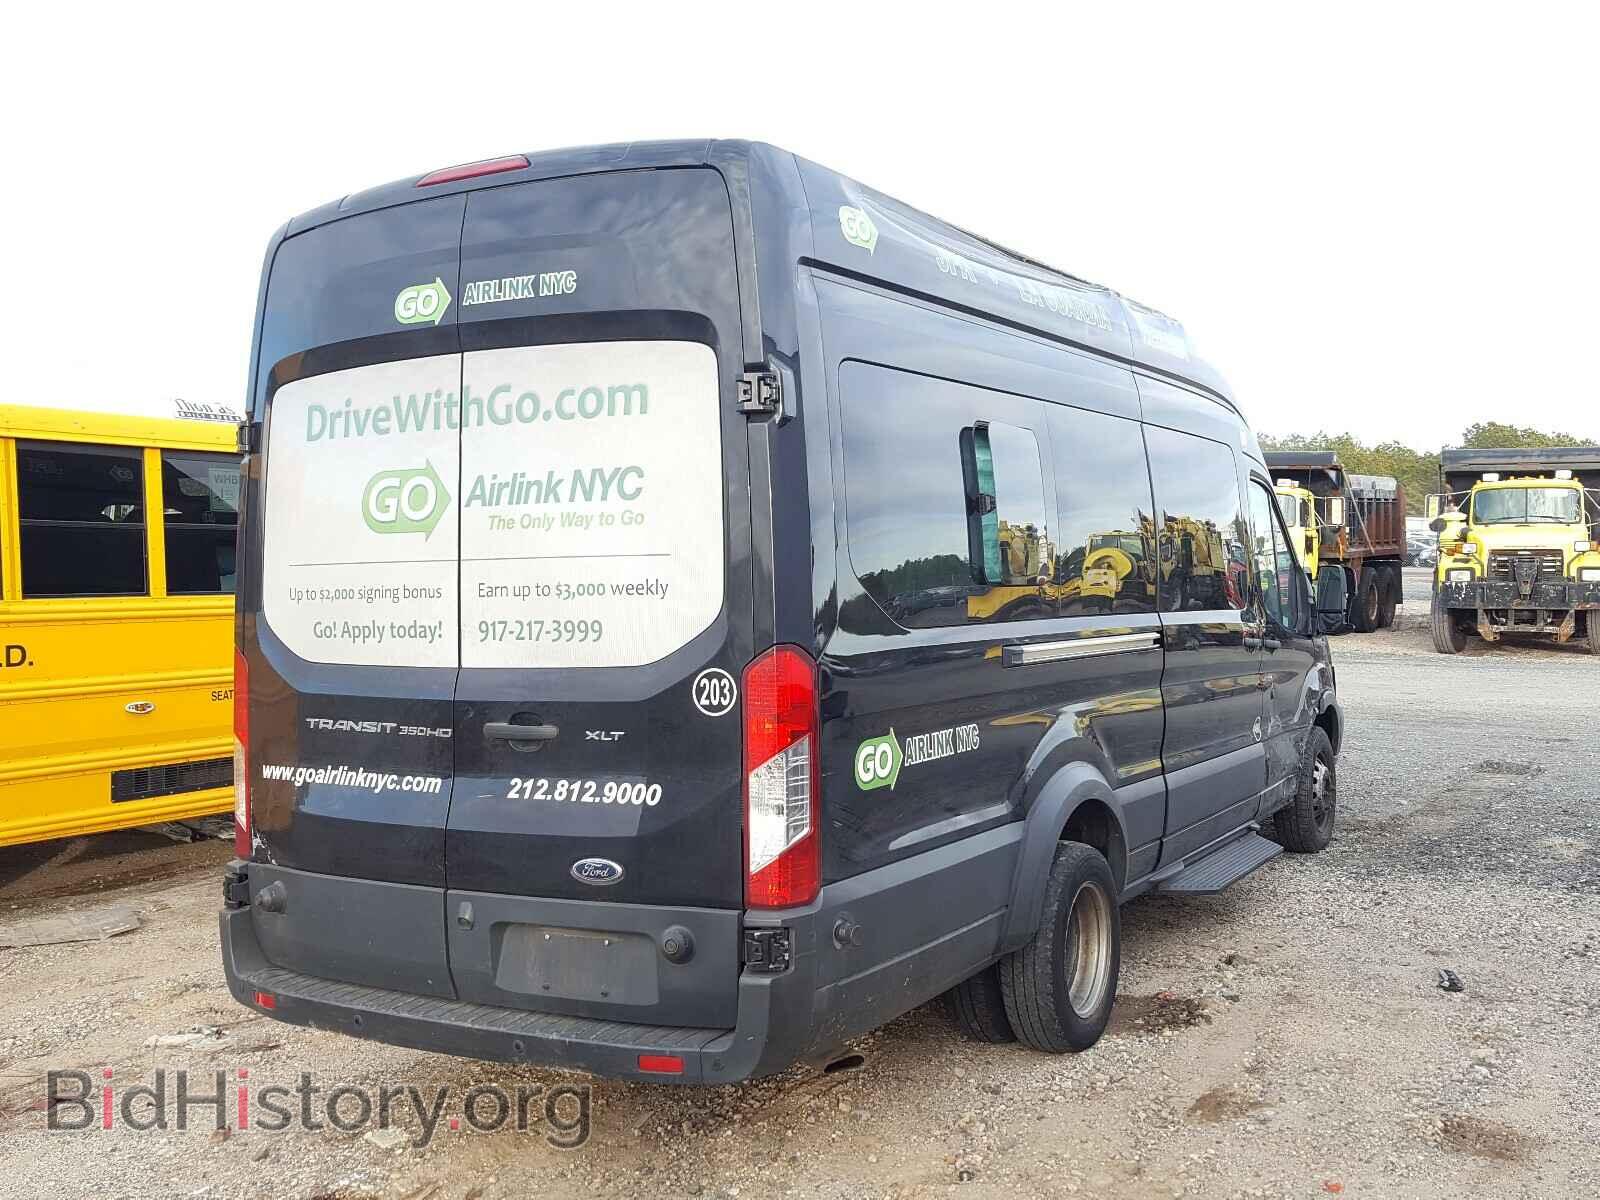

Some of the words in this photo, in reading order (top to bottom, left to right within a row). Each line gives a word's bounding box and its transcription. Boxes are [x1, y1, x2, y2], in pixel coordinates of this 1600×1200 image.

[399, 288, 440, 320] GO
[462, 274, 536, 307] AIRLINK
[538, 270, 577, 297] NYC
[306, 383, 649, 442] DriveWithGo.com
[368, 475, 438, 524] GO
[464, 470, 565, 508] Airlink
[568, 465, 645, 503] NYC
[488, 514, 516, 531] The
[519, 512, 556, 533] Only
[559, 511, 593, 531] Way
[599, 511, 616, 527] to
[620, 509, 646, 527] Go
[289, 587, 304, 604] Up
[306, 588, 317, 601] to
[319, 588, 355, 602] $2,000
[357, 585, 400, 604] signing
[403, 584, 443, 599] bonus
[477, 582, 509, 598] Earn
[512, 584, 532, 601] up
[535, 583, 551, 598] to
[554, 583, 607, 600] $3,000
[610, 578, 670, 600] weekly
[313, 620, 338, 639] Go!
[340, 619, 386, 644] Apply
[389, 619, 443, 644] today!
[478, 619, 604, 642] 917-217-3999
[699, 678, 731, 706] 203
[305, 717, 398, 734] TRANSIT
[399, 725, 452, 738] 350HD
[584, 730, 625, 741] XLT
[857, 742, 893, 783] GO
[904, 728, 955, 767] AIRLINK
[955, 723, 980, 753] NYC
[261, 764, 443, 794] www.goairlinknyc.com
[506, 777, 663, 807] 212.812.9000
[580, 863, 610, 878] Ford
